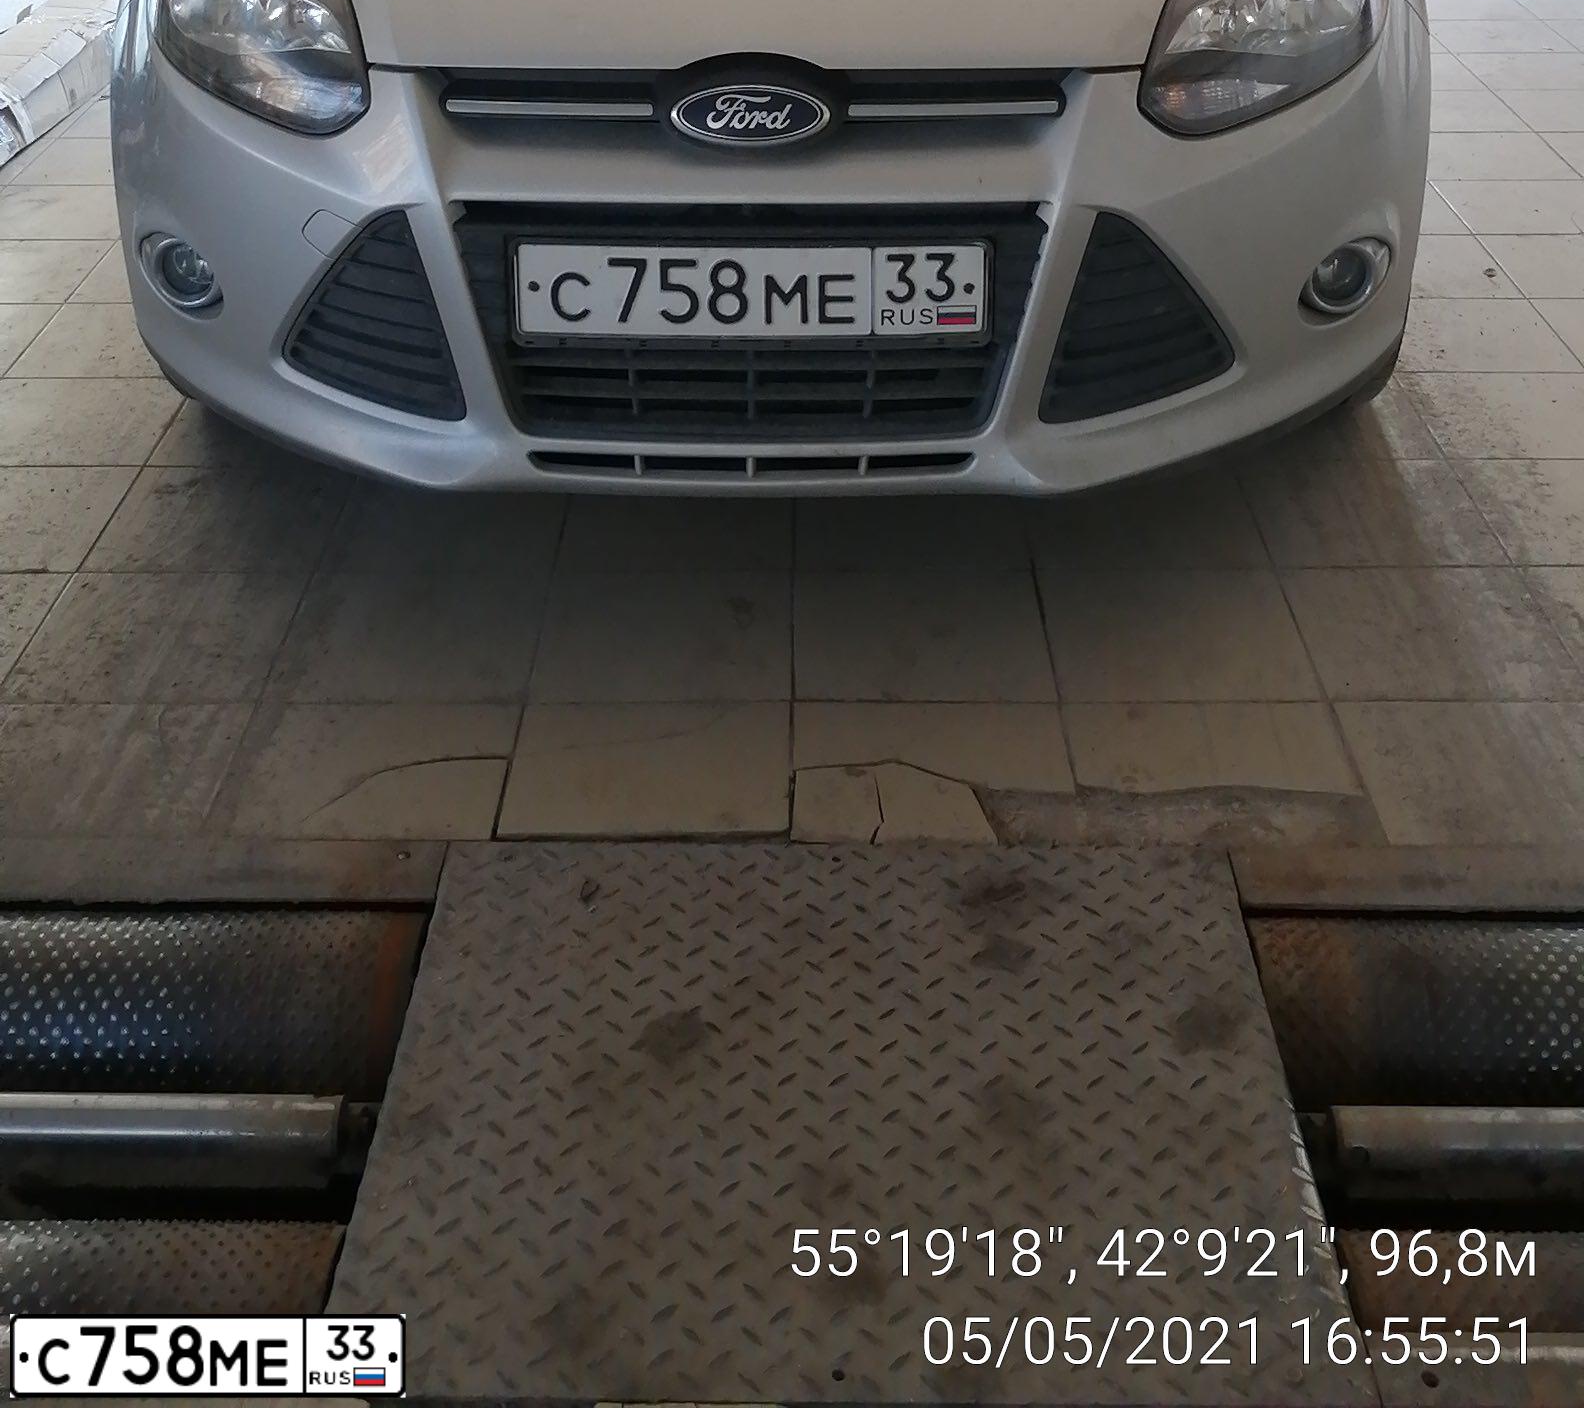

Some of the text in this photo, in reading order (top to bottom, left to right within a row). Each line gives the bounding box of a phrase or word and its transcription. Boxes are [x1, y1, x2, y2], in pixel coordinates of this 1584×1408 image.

[706, 93, 792, 131] Ford
[885, 253, 957, 304] 33
[880, 308, 934, 327] RUS
